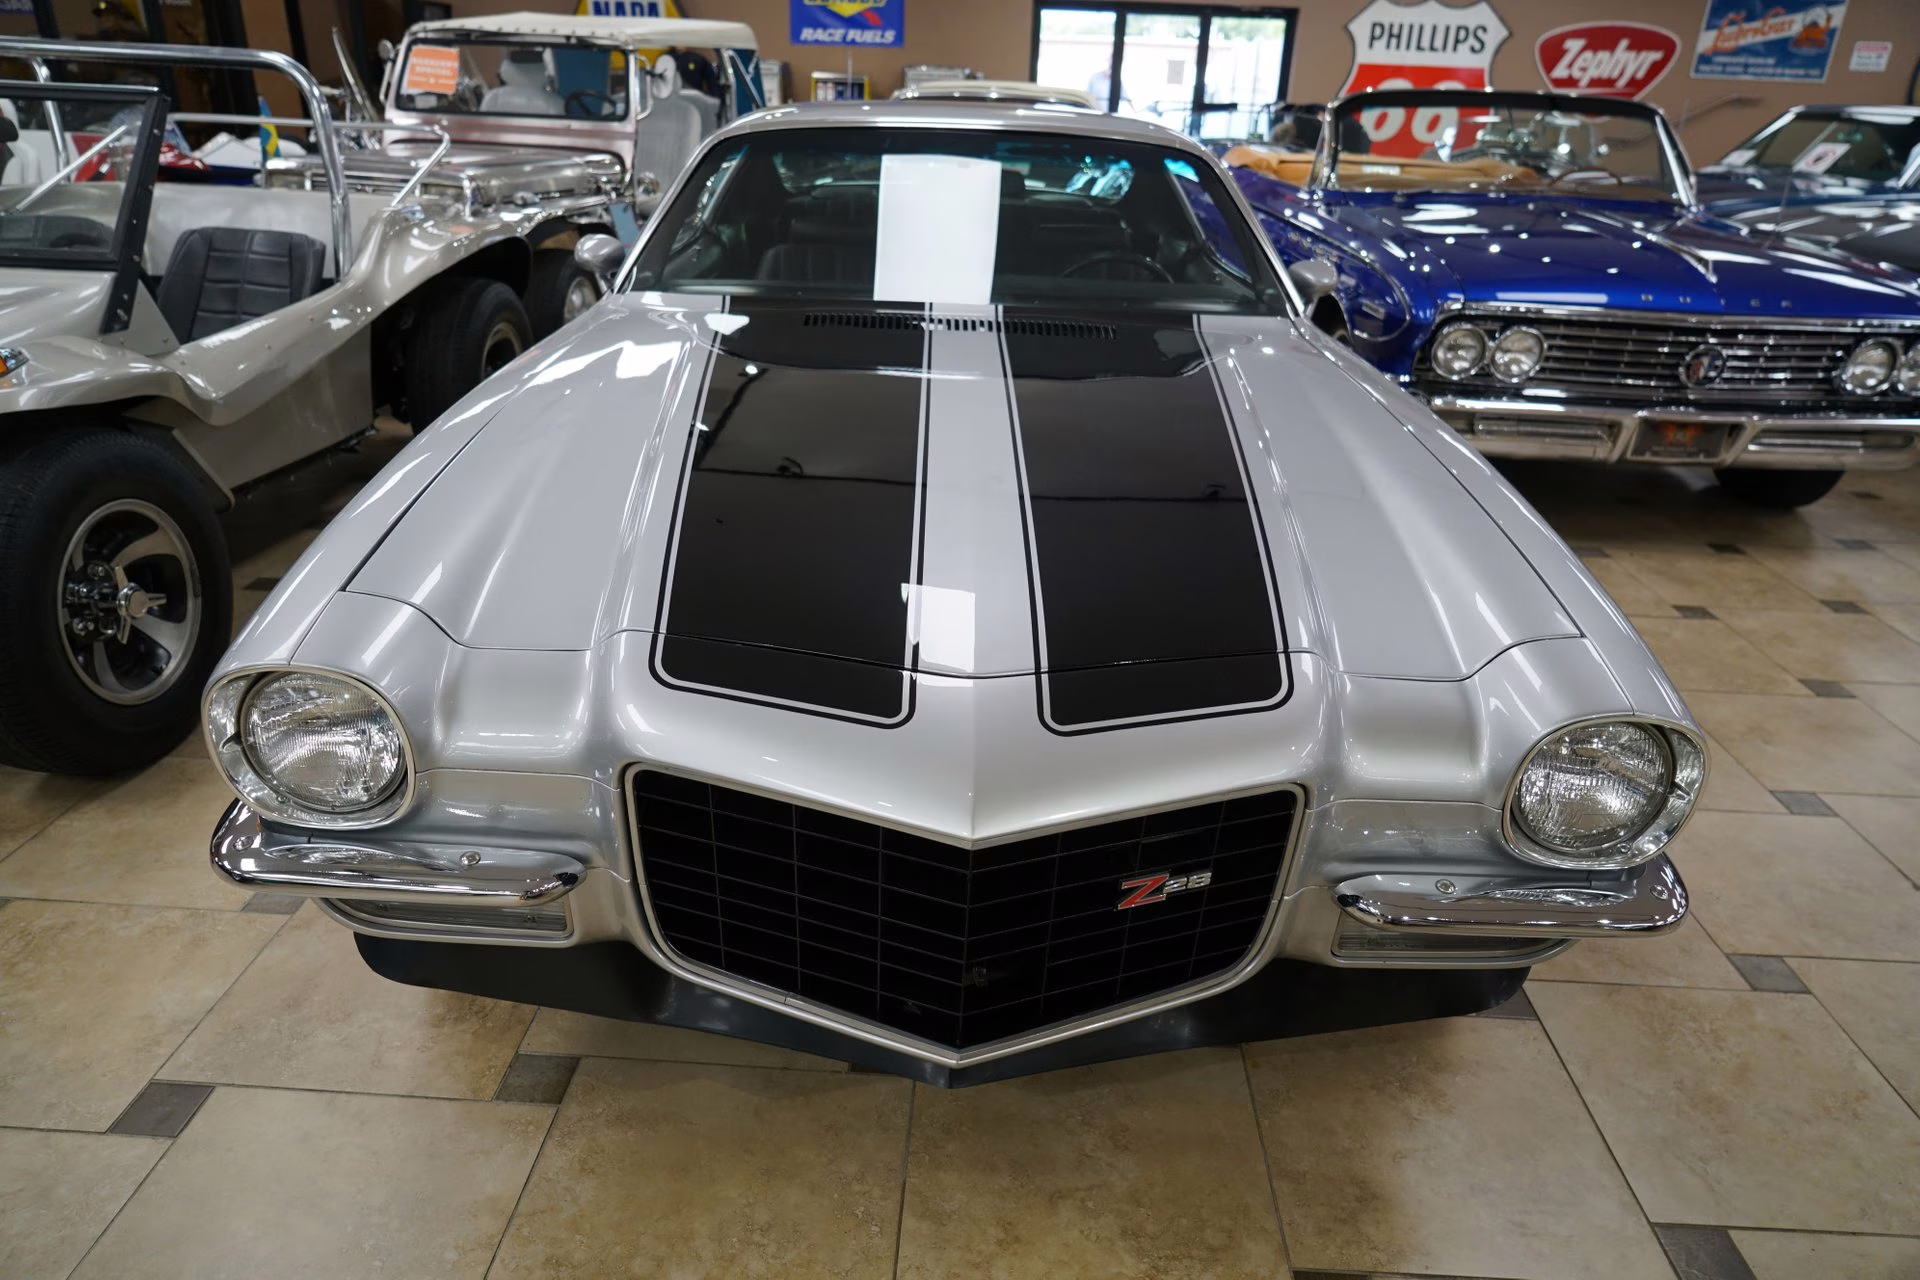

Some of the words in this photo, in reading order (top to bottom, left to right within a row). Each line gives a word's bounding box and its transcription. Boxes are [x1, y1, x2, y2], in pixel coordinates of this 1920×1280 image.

[800, 27, 846, 42] RACE
[846, 29, 896, 44] FUELS
[1368, 22, 1488, 54] PHILLIPS
[1550, 38, 1664, 89] Zephyr
[1117, 873, 1212, 910] Z28
